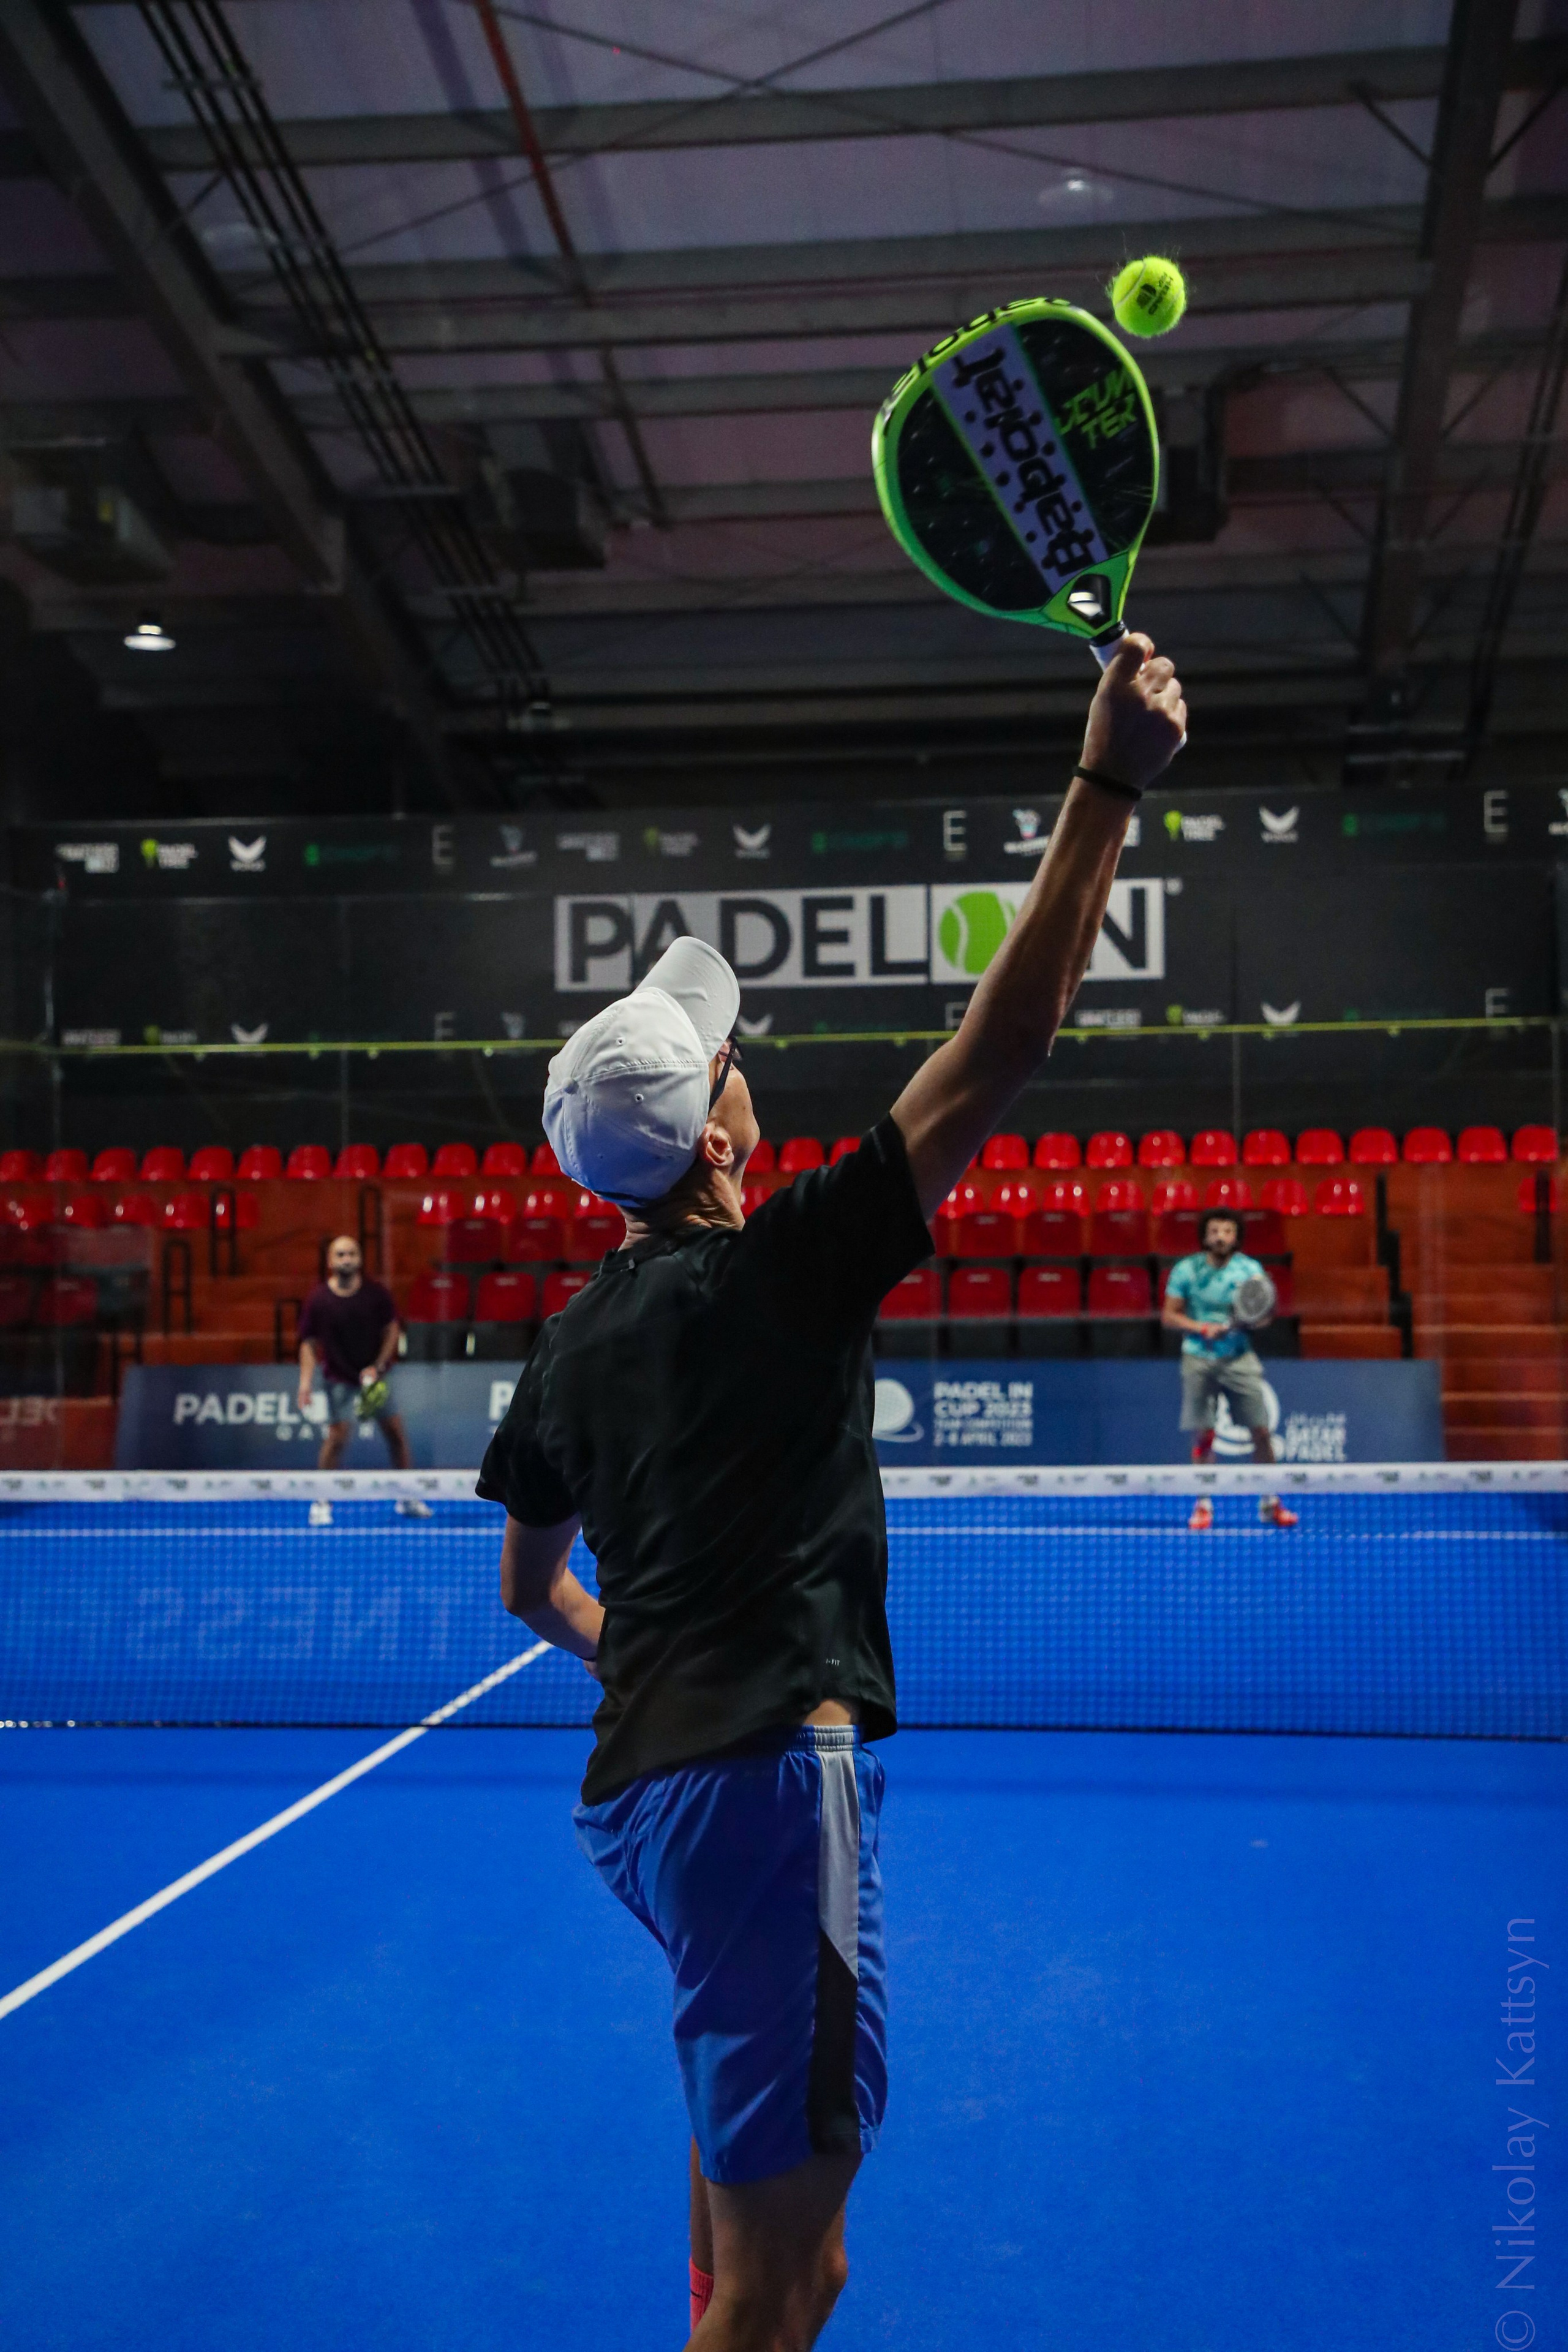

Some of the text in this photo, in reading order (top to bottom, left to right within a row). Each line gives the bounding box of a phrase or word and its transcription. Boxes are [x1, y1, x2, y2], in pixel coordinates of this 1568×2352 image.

[951, 346, 1096, 577] Babolat
[570, 894, 929, 982] PADEL
[933, 1381, 1034, 1401] PADEL IN
[173, 1392, 300, 1425] PADEL
[933, 1400, 981, 1419] CUP
